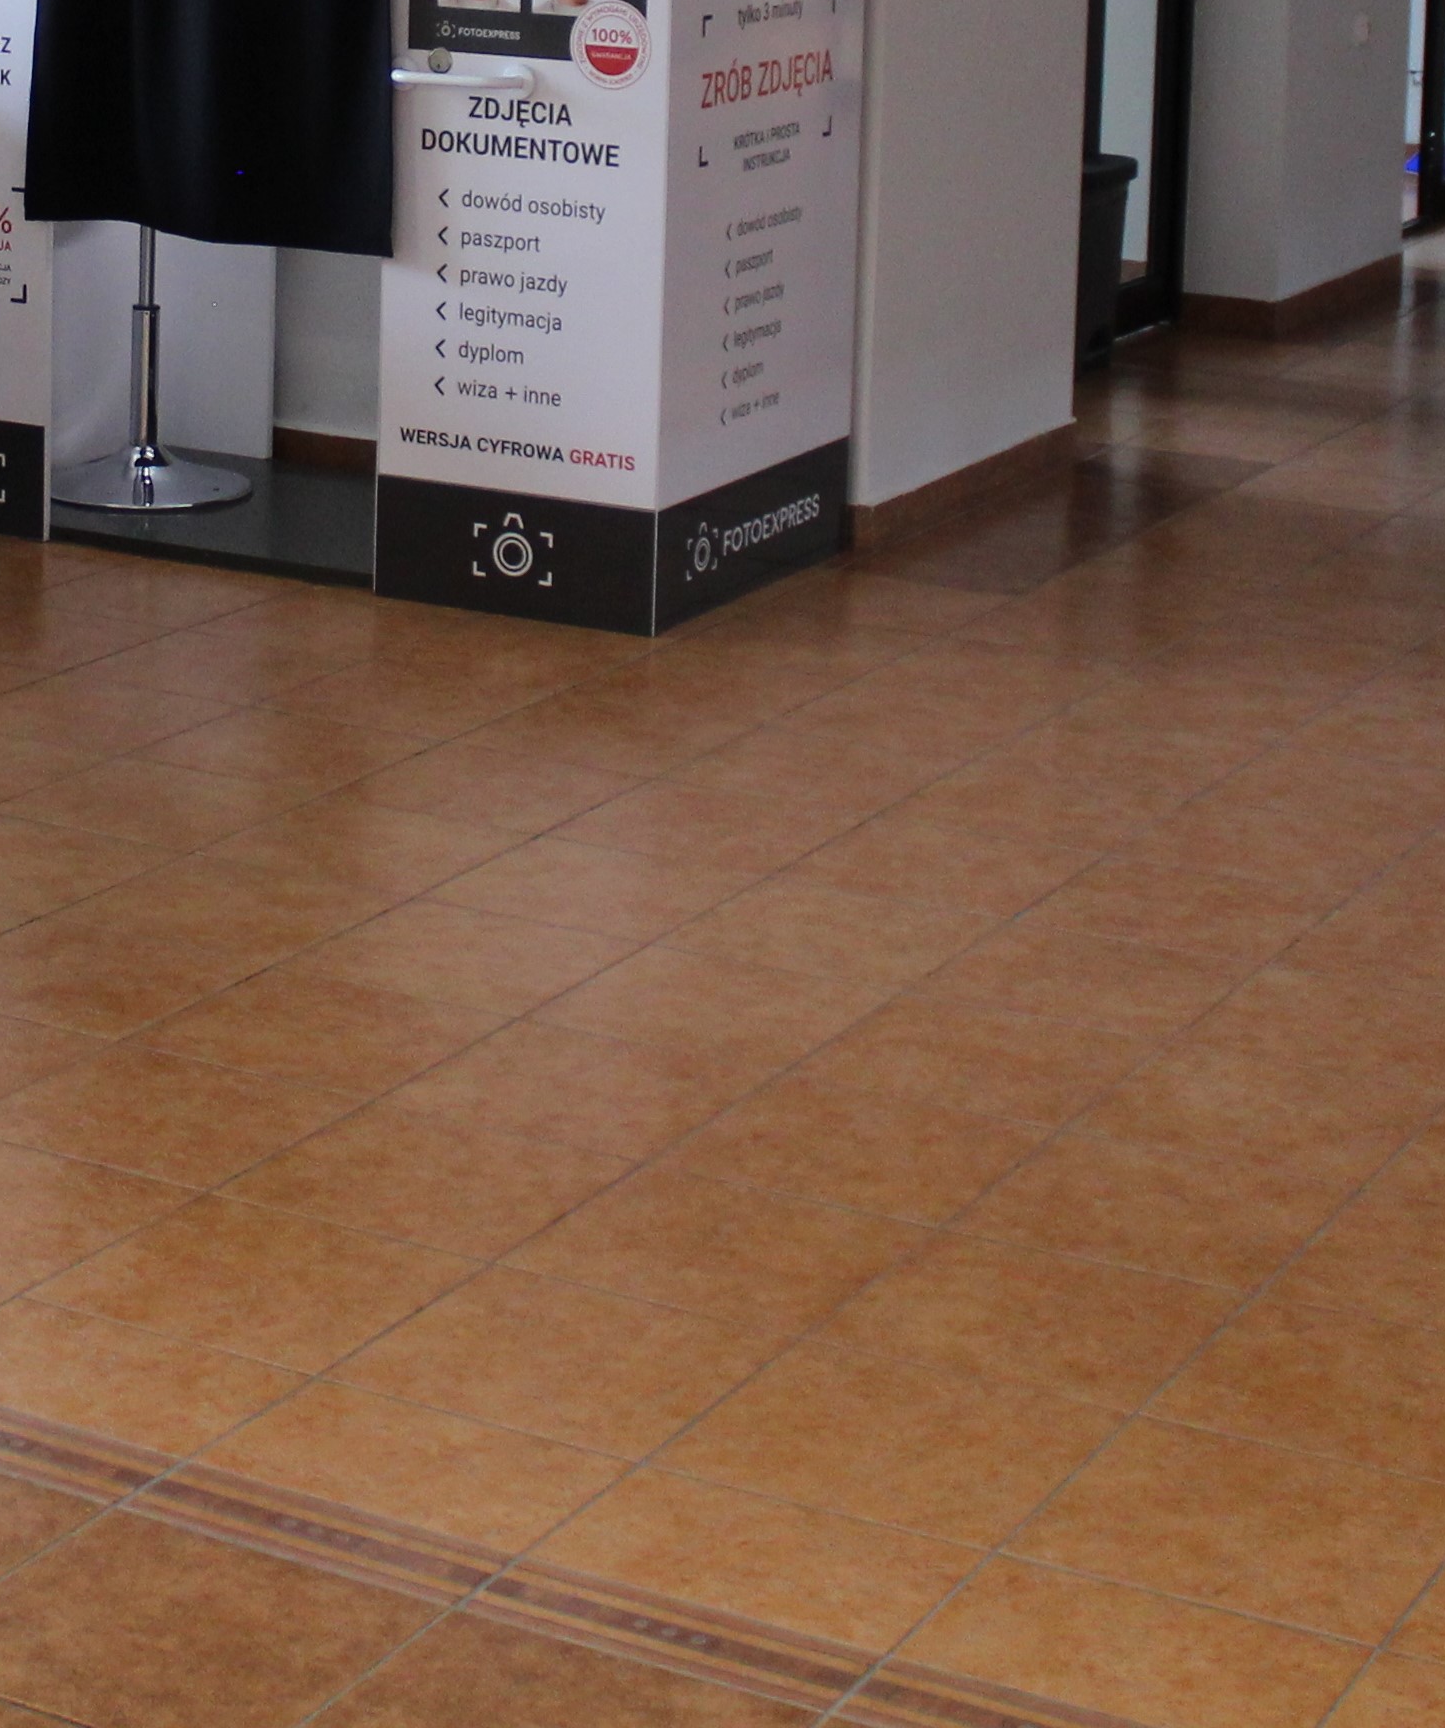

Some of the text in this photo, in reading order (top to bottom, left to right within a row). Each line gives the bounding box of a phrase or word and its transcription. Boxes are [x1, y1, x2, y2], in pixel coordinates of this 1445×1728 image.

[458, 27, 520, 40] FOTOEXPRESS
[591, 28, 633, 45] 100%
[701, 49, 834, 109] ZRÓB ZDJĘCIA
[469, 94, 571, 128] ZDJĘCIA
[420, 128, 619, 167] DOKUMENTOWE
[462, 190, 605, 225] dowód osobisty
[459, 231, 541, 255] paszport
[460, 269, 567, 297] prawo jazdy
[459, 303, 562, 334] legitymacja
[458, 341, 524, 364] dyplom
[458, 382, 497, 399] wiza
[523, 390, 561, 407] inne
[400, 427, 635, 471] WERSJA CYFROWA GRATIS
[723, 493, 819, 556] FOTOEXPRESS
